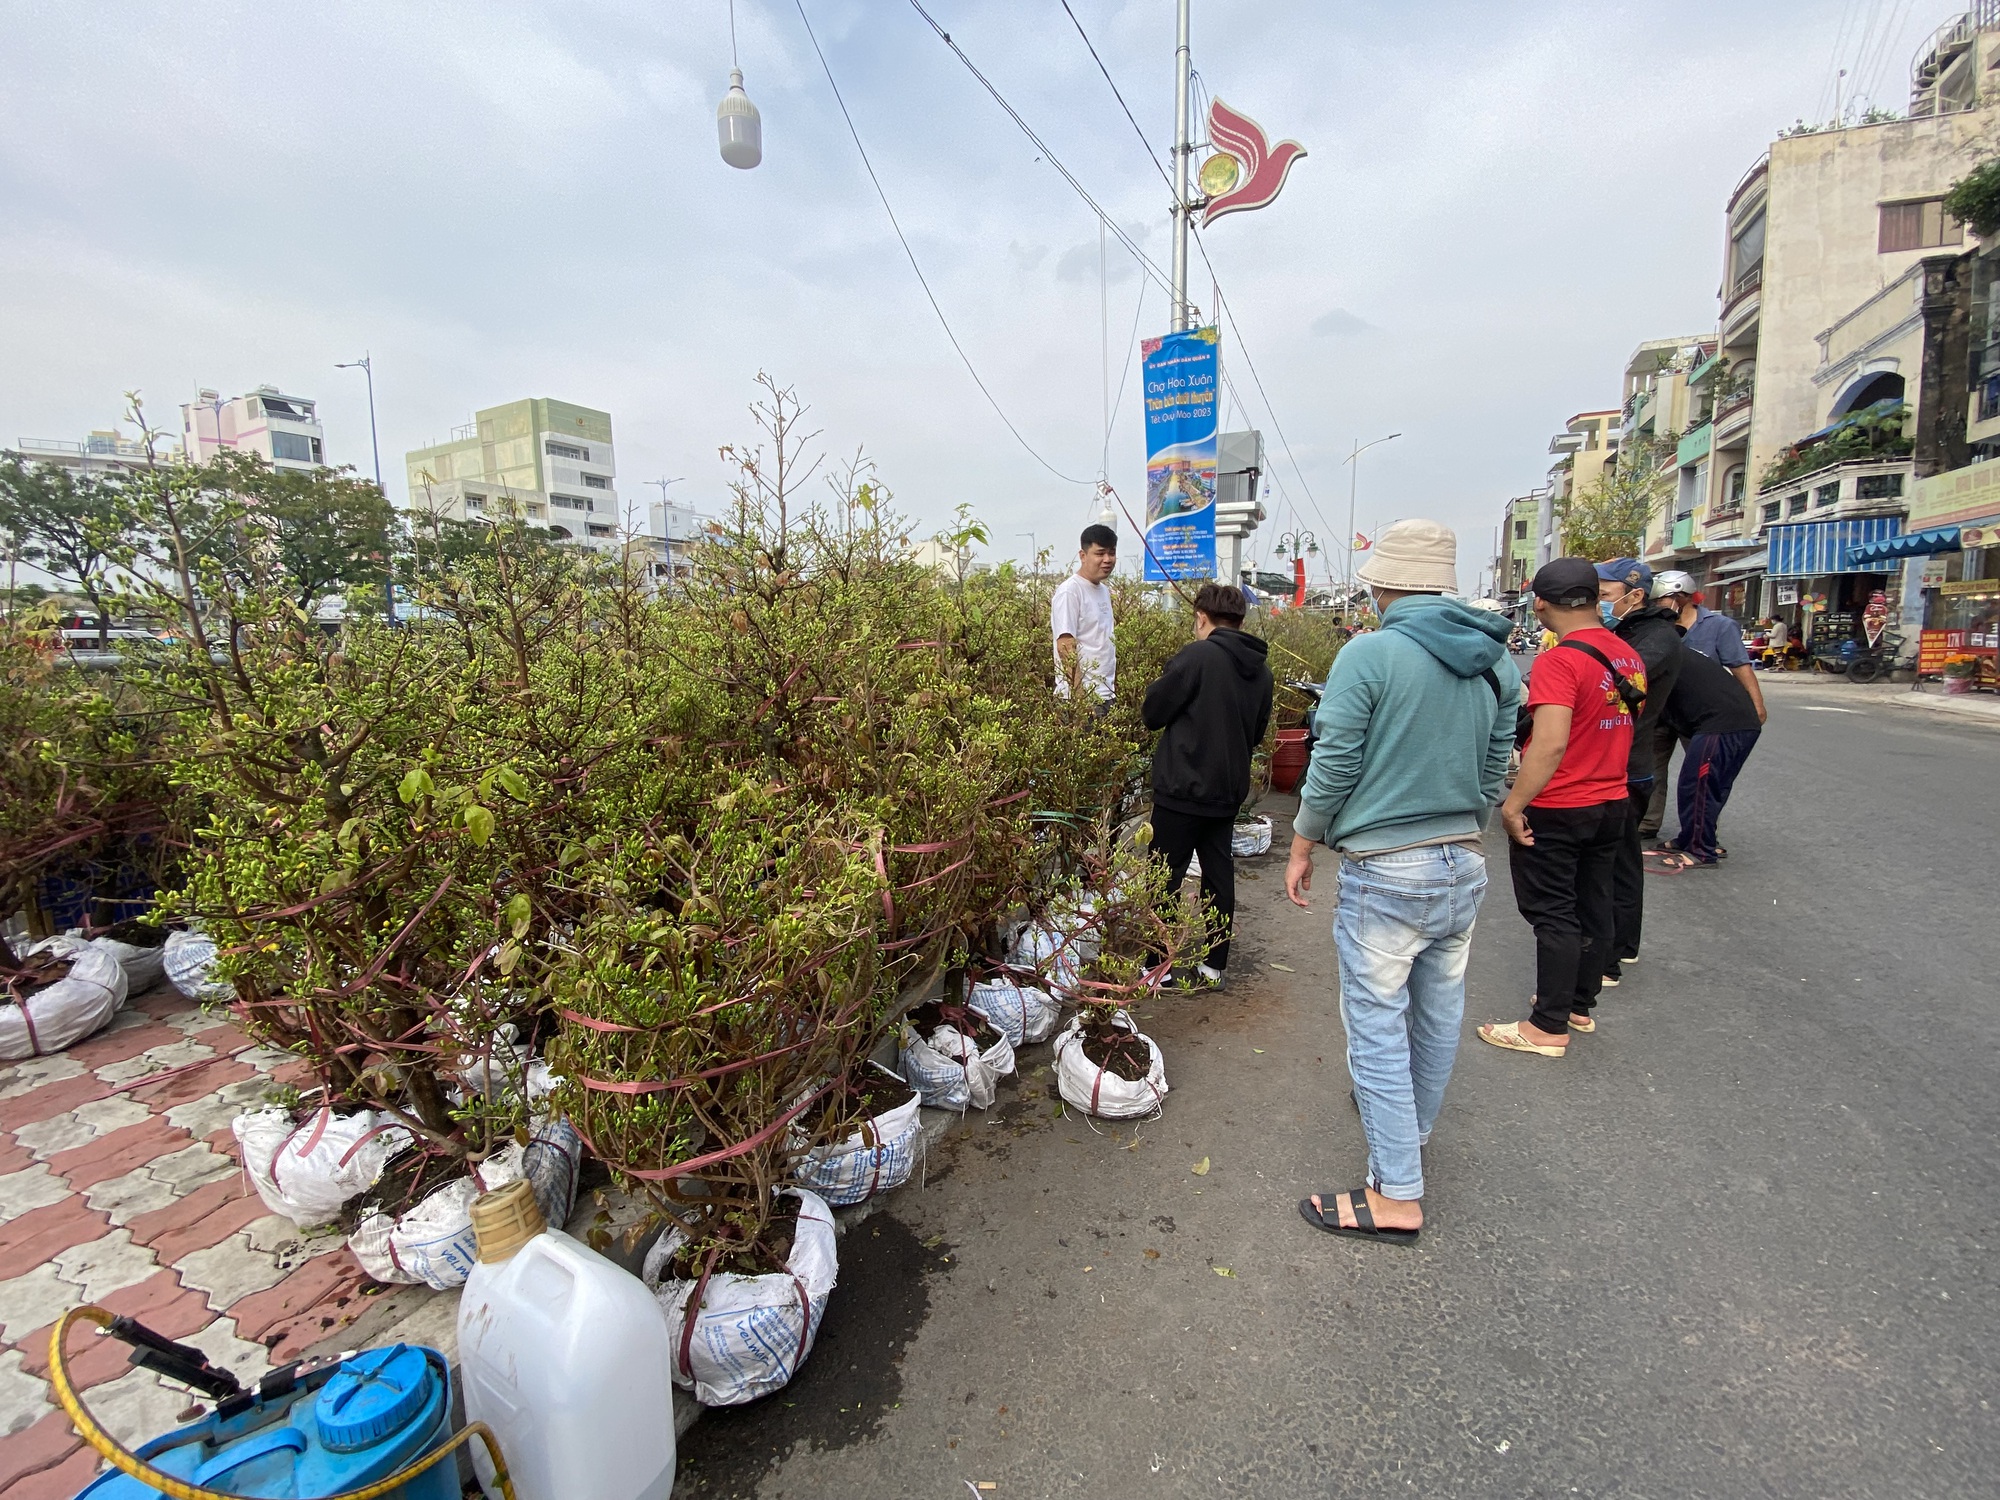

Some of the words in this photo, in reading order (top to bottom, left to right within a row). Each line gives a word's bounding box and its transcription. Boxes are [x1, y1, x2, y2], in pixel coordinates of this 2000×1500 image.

[1147, 381, 1166, 393] Chợ
[1167, 377, 1186, 390] Hoa
[1188, 373, 1213, 387] Xuân
[1150, 415, 1161, 425] Tết
[1192, 407, 1212, 418] 2023
